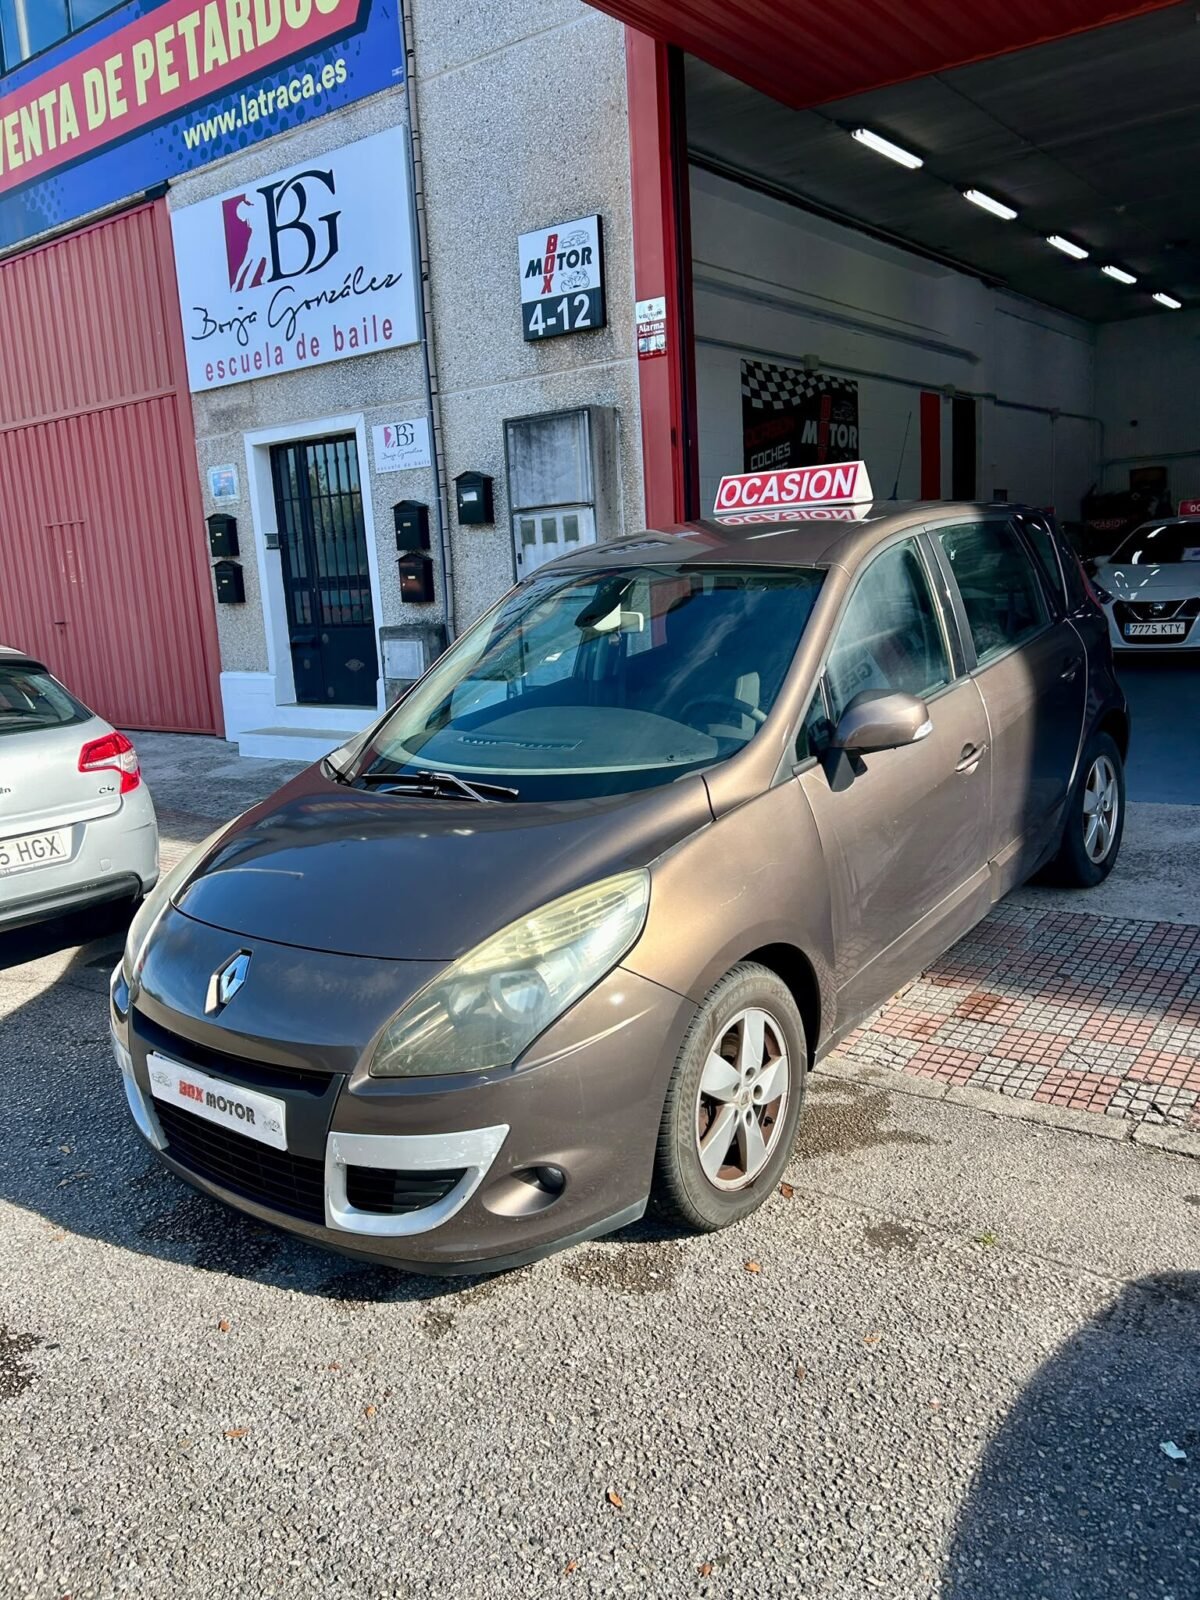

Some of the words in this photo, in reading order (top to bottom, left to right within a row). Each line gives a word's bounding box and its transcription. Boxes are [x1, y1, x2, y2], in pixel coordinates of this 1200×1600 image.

[0, 82, 80, 177] ENTA
[83, 53, 128, 131] DE
[183, 58, 347, 150] www.latraca.es
[257, 169, 342, 284] BG
[541, 233, 559, 295] BOX
[192, 307, 257, 347] Borja
[267, 266, 402, 342] González
[528, 293, 591, 336] 4-12
[205, 342, 283, 381] escuela
[296, 333, 320, 360] de
[333, 314, 393, 352] baile
[750, 441, 791, 471] COCHES
[720, 467, 856, 507] OCASION
[1132, 624, 1158, 634] 7775
[1161, 623, 1181, 633] KTY
[99, 786, 115, 794] C4
[16, 836, 60, 862] HGX
[178, 1080, 204, 1103] BOX
[205, 1091, 256, 1125] MOTOR
